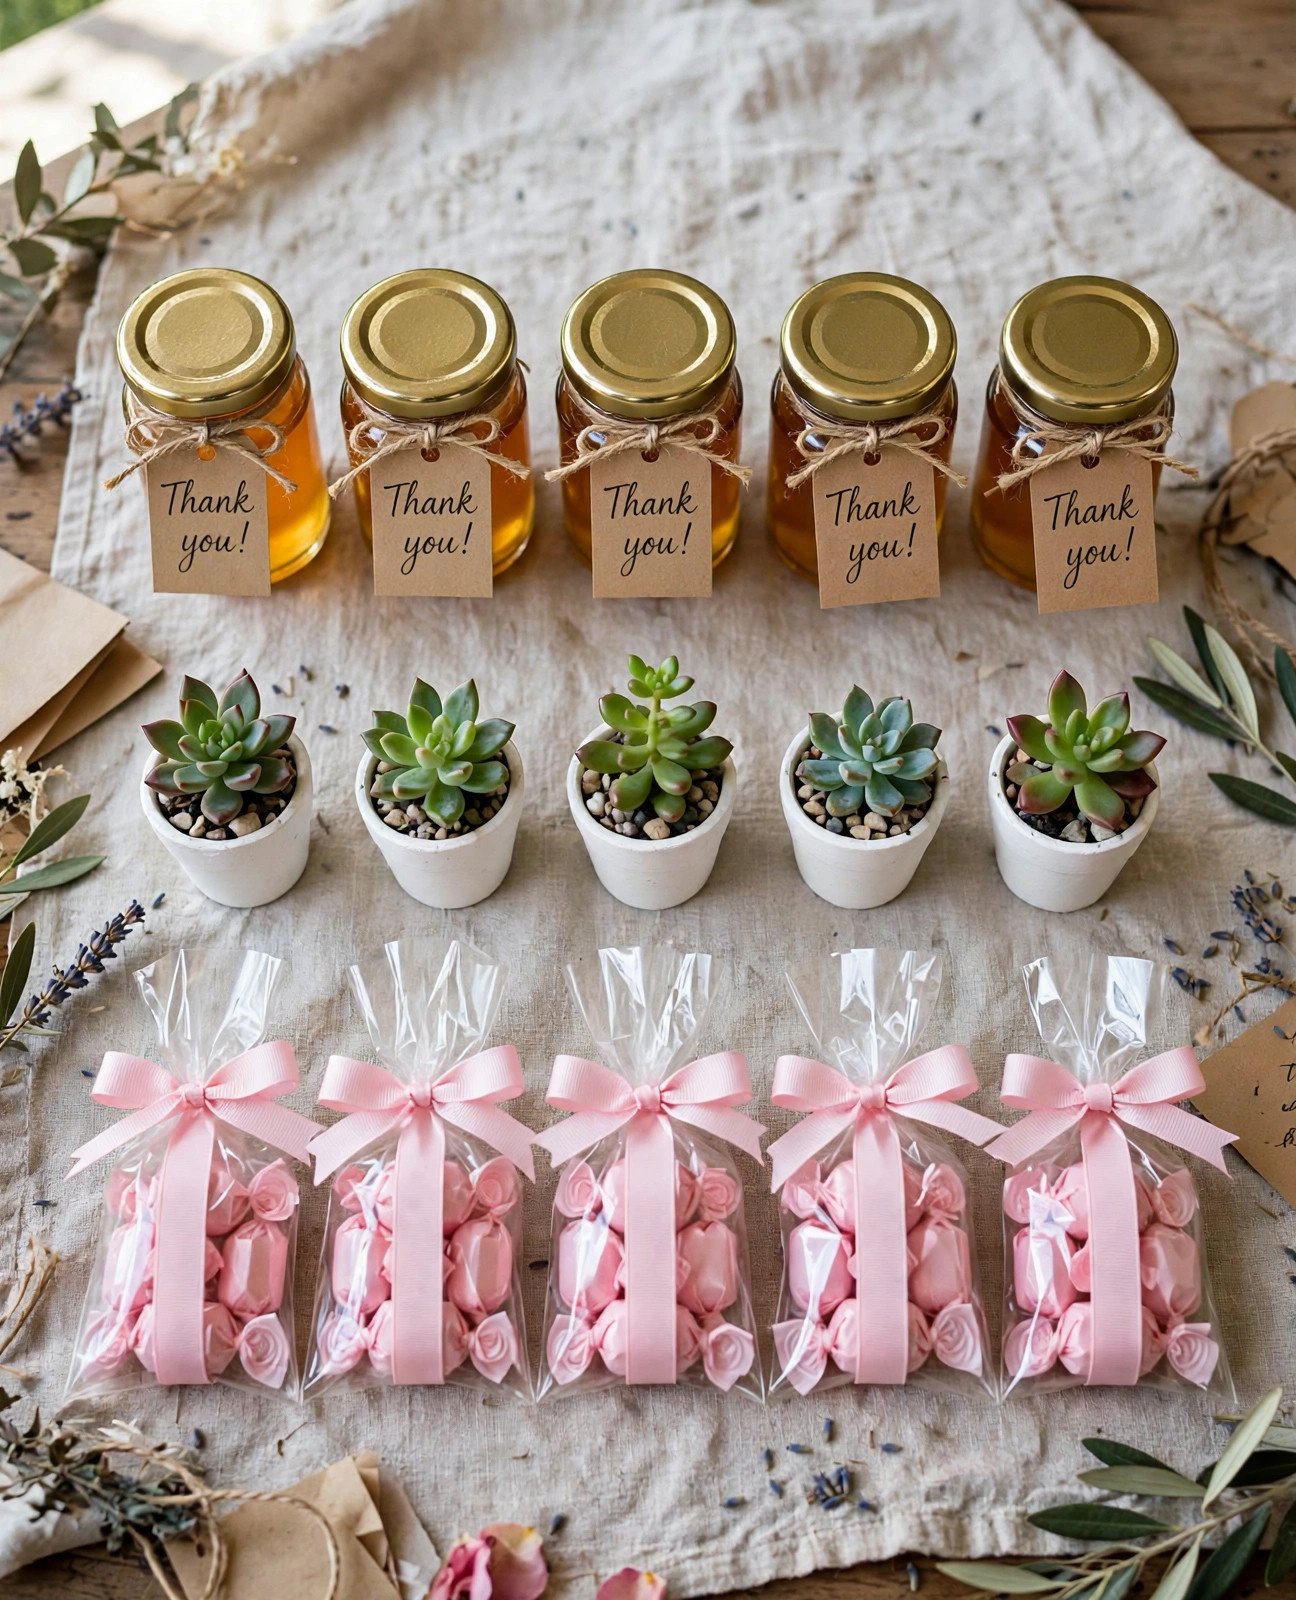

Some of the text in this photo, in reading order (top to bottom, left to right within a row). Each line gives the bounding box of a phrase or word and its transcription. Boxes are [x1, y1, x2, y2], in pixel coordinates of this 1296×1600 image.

[160, 478, 255, 517] Thank
[383, 479, 479, 518] Thank
[603, 480, 699, 520] Thank
[825, 480, 922, 527] Thank
[1043, 483, 1140, 531] Thank
[178, 520, 250, 573] you!
[400, 521, 473, 576] you!
[620, 521, 693, 577] you!
[845, 522, 917, 585] you!
[1063, 525, 1135, 590] you!
